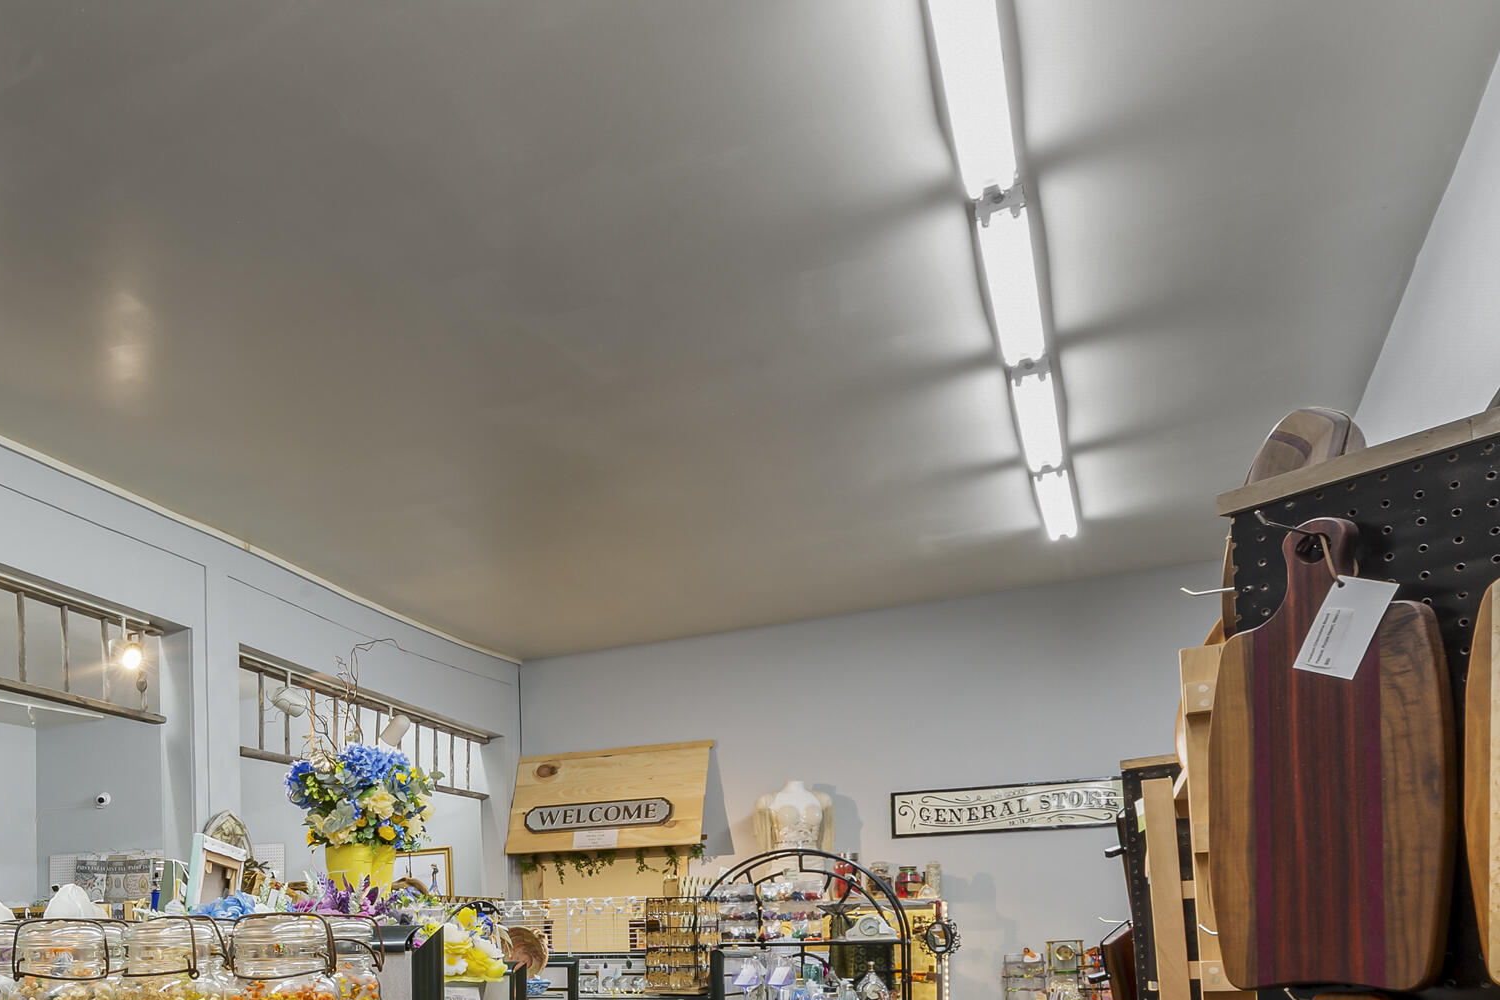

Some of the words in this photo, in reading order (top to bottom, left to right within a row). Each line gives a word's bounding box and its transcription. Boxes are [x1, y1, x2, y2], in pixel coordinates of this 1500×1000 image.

[538, 803, 658, 826] WELCOME
[918, 798, 1032, 824] GENERAL
[1039, 789, 1120, 811] STORE
